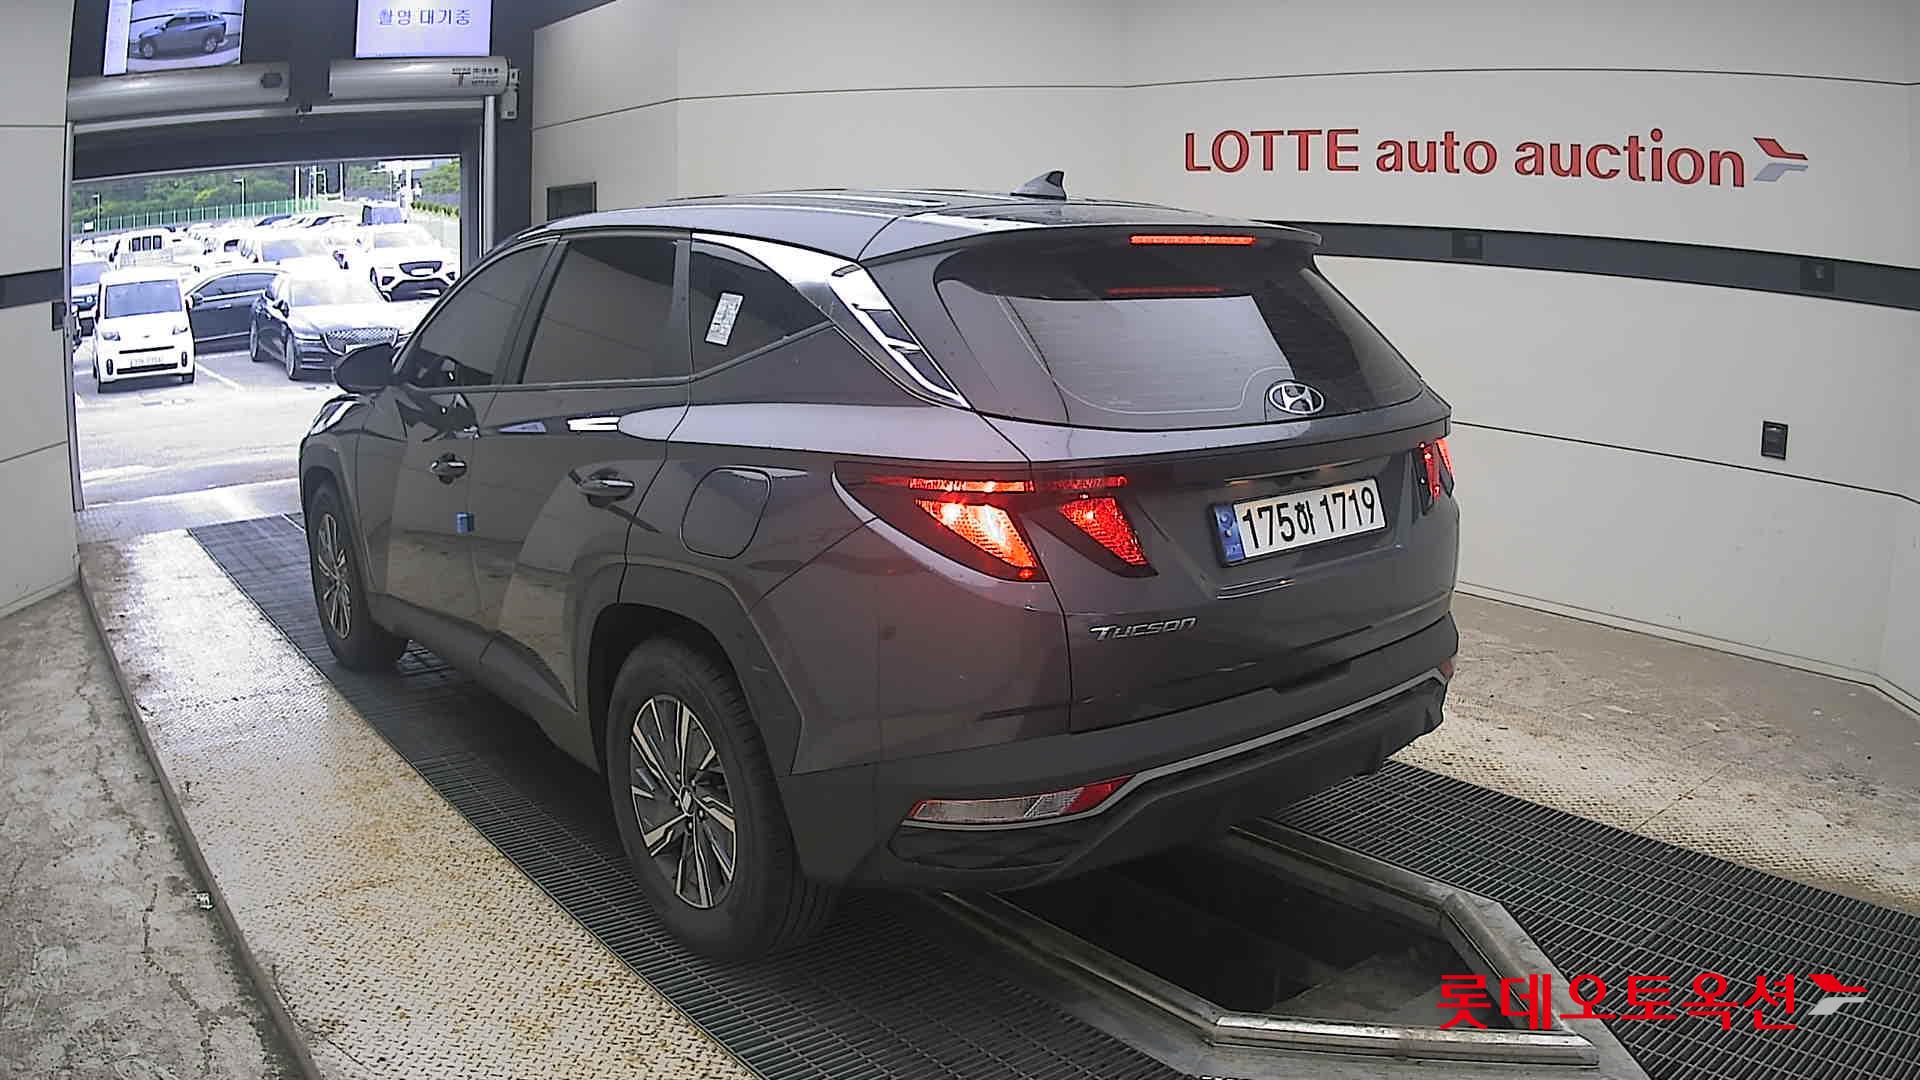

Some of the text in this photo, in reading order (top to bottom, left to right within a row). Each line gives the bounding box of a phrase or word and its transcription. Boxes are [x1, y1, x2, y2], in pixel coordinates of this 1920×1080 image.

[419, 8, 473, 26] 대기중
[1184, 127, 1746, 188] LOTTE auto auction
[1243, 486, 1375, 549] 175하 1719
